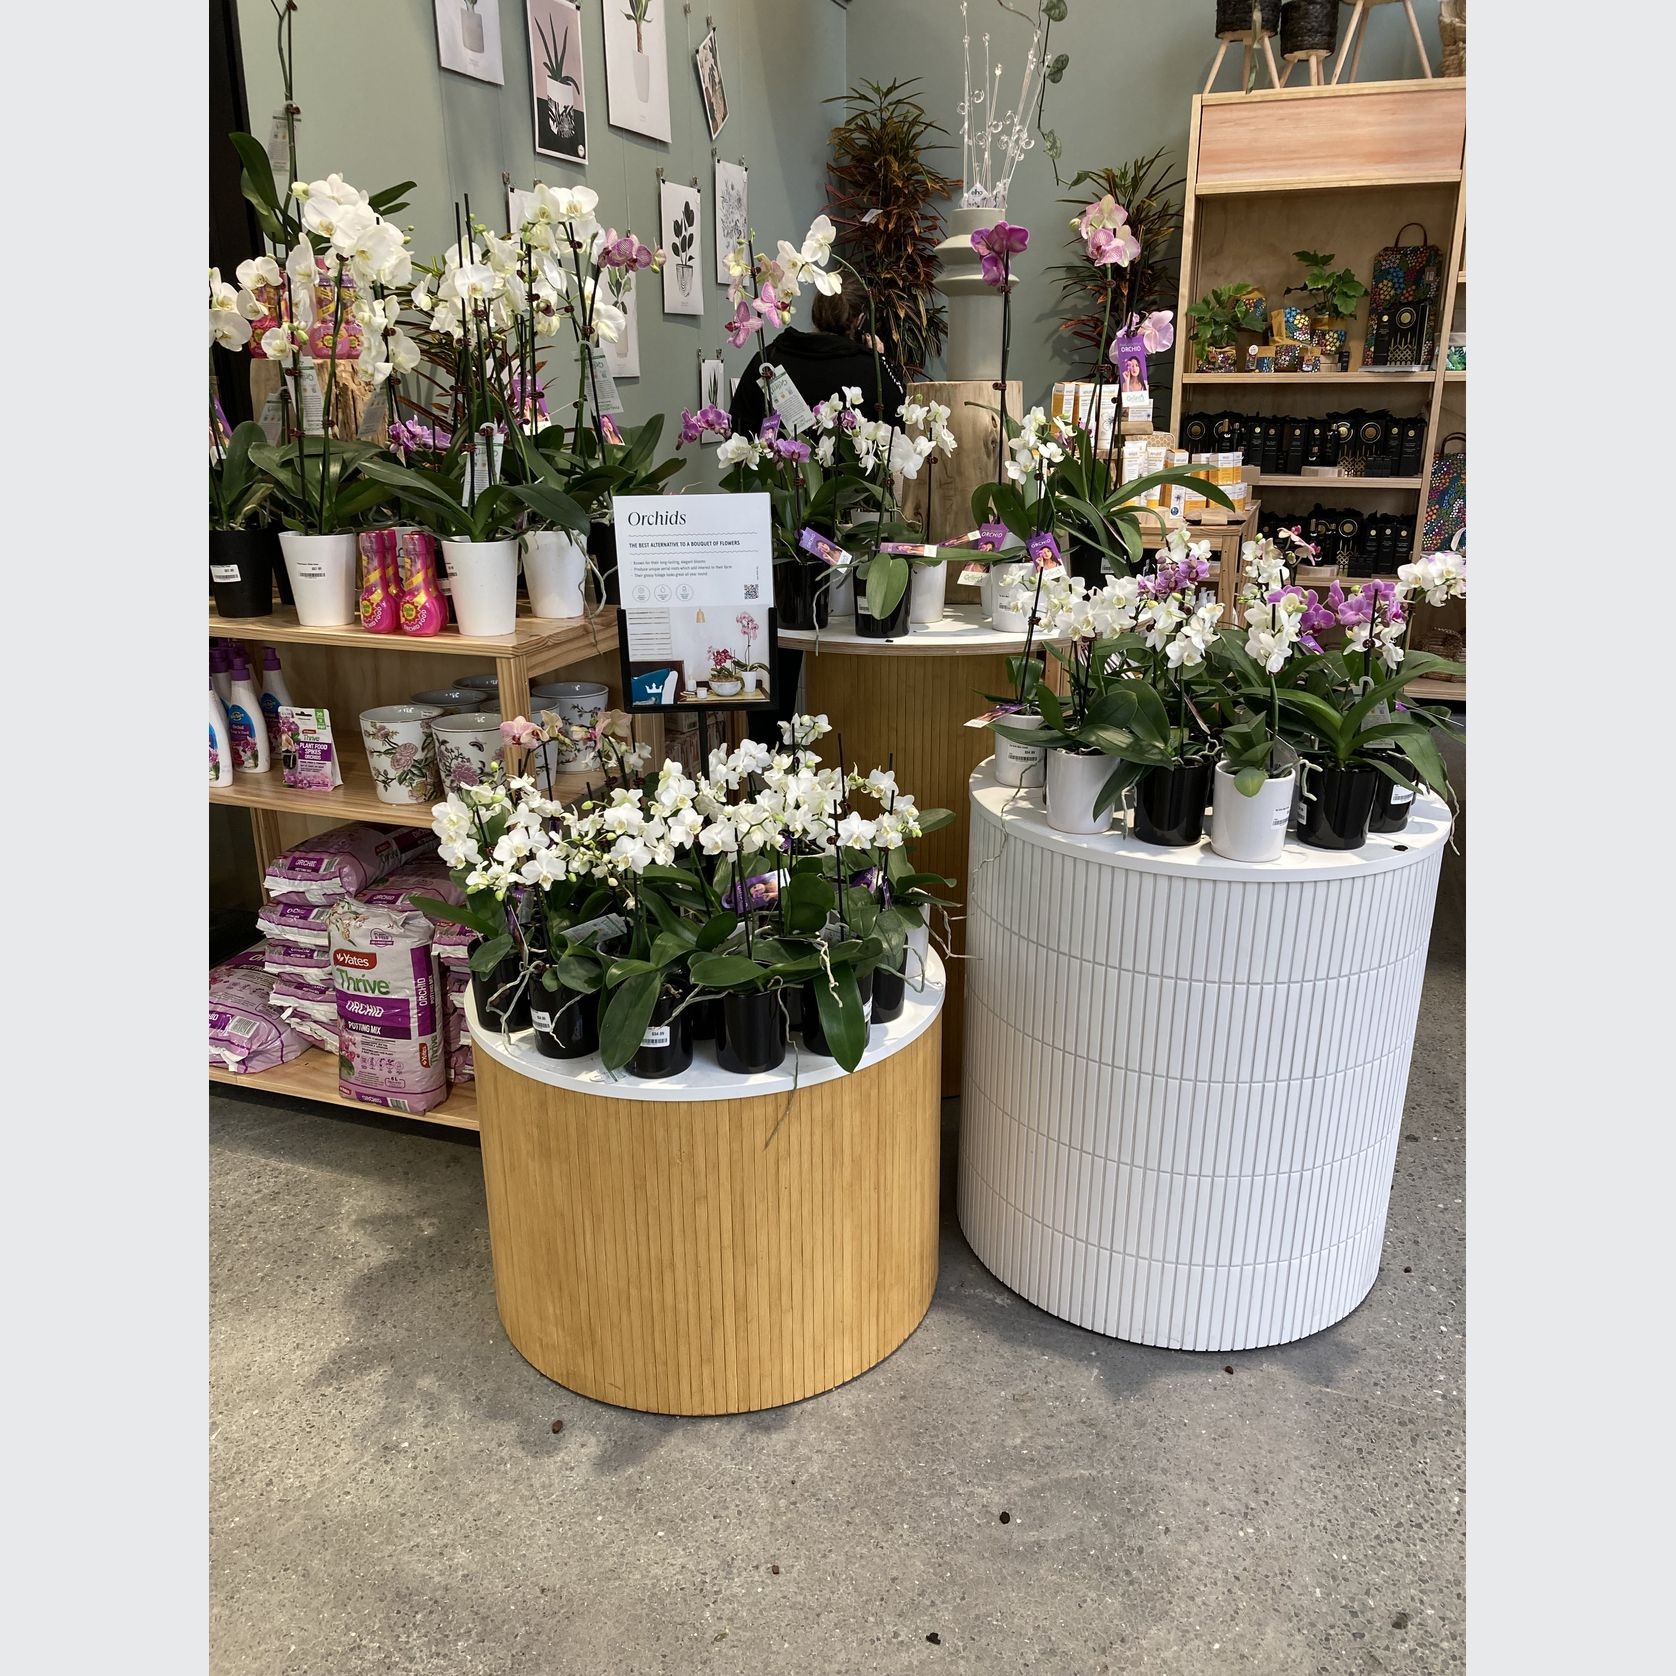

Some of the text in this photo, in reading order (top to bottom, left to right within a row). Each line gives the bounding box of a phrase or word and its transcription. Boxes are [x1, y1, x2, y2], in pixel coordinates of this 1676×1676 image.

[1120, 345, 1142, 353] ORCHID
[627, 510, 687, 527] Orchids
[1030, 538, 1051, 549] ORCHID
[374, 606, 383, 623] FOOD
[419, 609, 427, 626] FOOD
[303, 734, 321, 742] Thrive
[343, 952, 370, 967] Yates
[336, 967, 391, 995] Thrive
[416, 977, 428, 1007] ORCHID
[345, 1000, 385, 1018] ORCHID
[347, 1020, 382, 1035] POTTING MIX
[430, 1036, 438, 1066] Thrive
